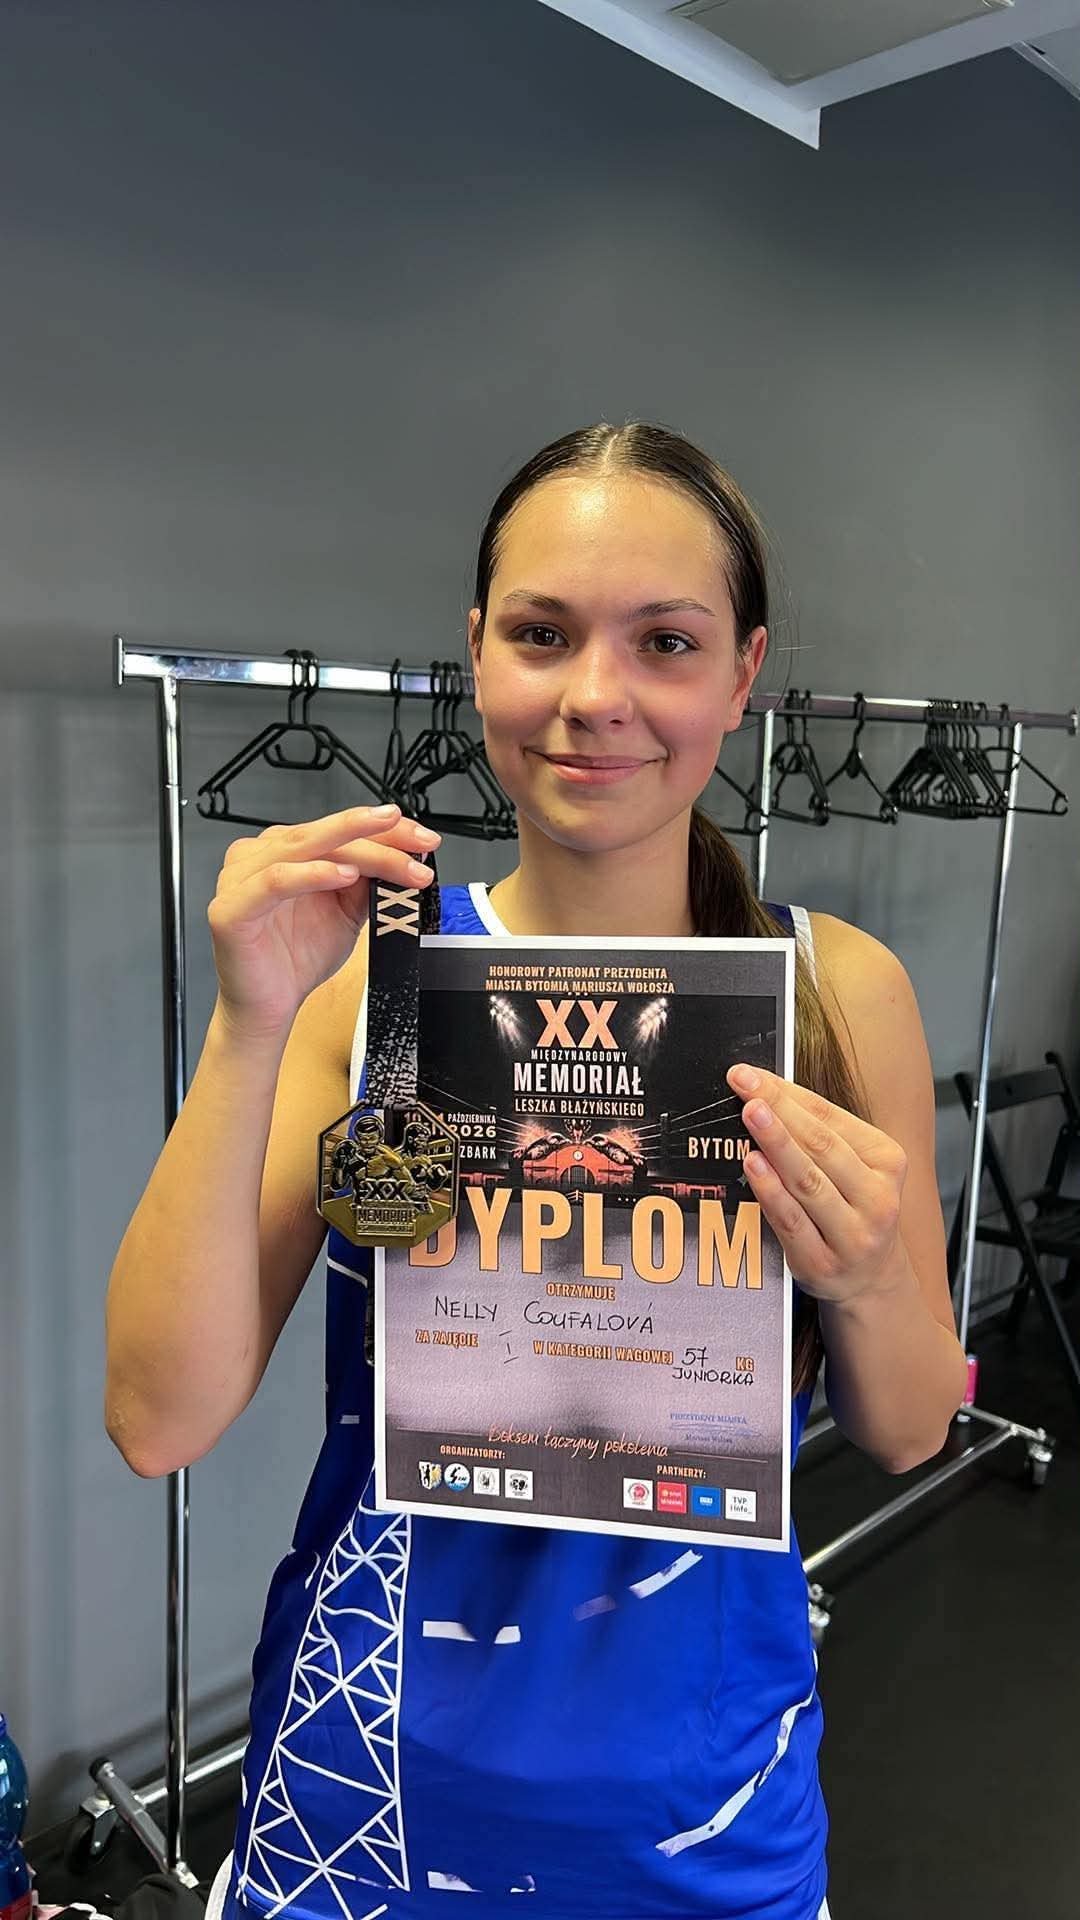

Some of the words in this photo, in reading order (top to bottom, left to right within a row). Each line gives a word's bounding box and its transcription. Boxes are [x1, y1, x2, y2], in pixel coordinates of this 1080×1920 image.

[376, 886, 419, 936] XX
[489, 965, 544, 977] HONOROWY
[548, 966, 600, 978] PATRONAT
[603, 967, 668, 979] PREZYDENTA
[485, 979, 522, 990] MIASTA
[525, 980, 571, 991] BYTOMIA
[572, 981, 624, 992] MARIUSZA
[627, 982, 675, 993] WOŁOSZA
[536, 999, 619, 1049] XX
[531, 1049, 628, 1062] MIĘDZYNARODOWY
[513, 1062, 645, 1095] MEMORIAŁ
[515, 1098, 555, 1112] LESZKA
[560, 1099, 645, 1116] BŁAŻYŃSKIEGO
[447, 1112, 496, 1124] PAŹDZIERNIKA
[688, 1136, 751, 1160] BYTOM
[546, 1282, 616, 1301] OTRZYMUJE
[435, 1295, 498, 1321] NELLY
[415, 1328, 430, 1343] ZA
[433, 1330, 480, 1348] ZAJĘCIE
[533, 1340, 545, 1355] W
[547, 1341, 612, 1361] KATEGORII
[615, 1346, 674, 1365] WAGOWEJ
[681, 1346, 709, 1368] 57
[735, 1356, 755, 1371] KG
[672, 1367, 754, 1386] JUNIORKA
[488, 1422, 539, 1446] Boksem
[544, 1425, 600, 1460] łączymy
[602, 1432, 669, 1459] pokolenia
[440, 1445, 506, 1459] ORGANIZATORZY:
[656, 1464, 707, 1479] PARTNERZY:
